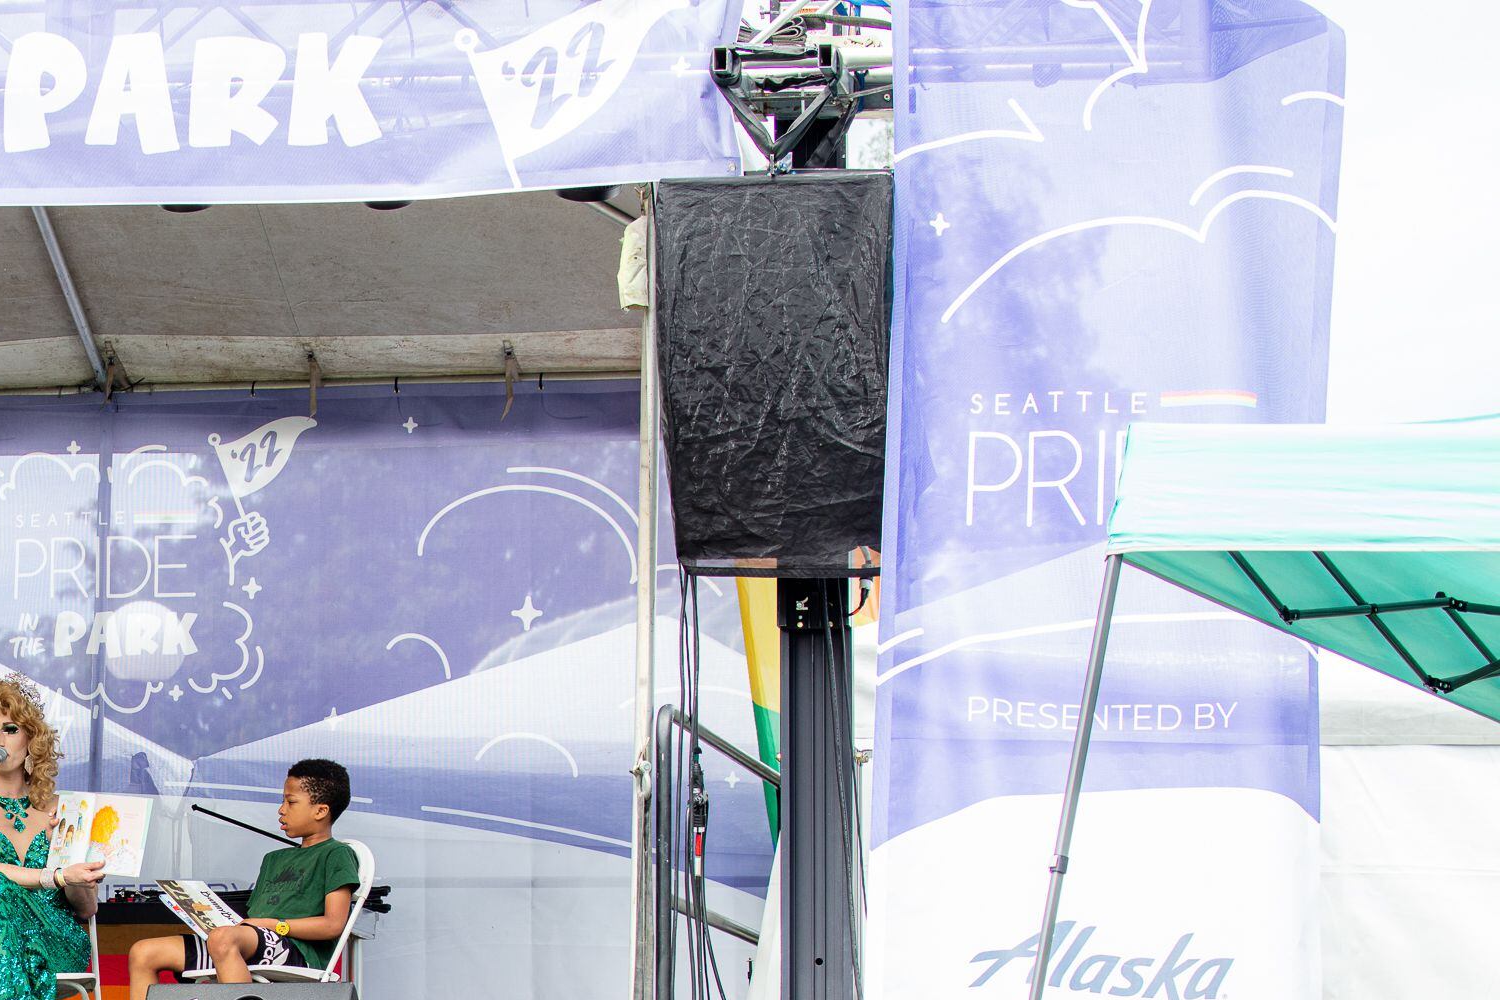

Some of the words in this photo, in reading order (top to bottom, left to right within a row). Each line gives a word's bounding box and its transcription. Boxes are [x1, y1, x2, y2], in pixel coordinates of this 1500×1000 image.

[3, 31, 384, 156] PARK
[969, 391, 1148, 415] SEATTLE
[965, 429, 1127, 528] PRI
[14, 510, 125, 528] SEATTLE
[13, 534, 198, 601] PRIDE
[18, 612, 40, 633] IN
[53, 610, 199, 659] PARK
[9, 636, 47, 660] THE
[967, 695, 1183, 731] PRESENTED
[1193, 701, 1239, 730] BY
